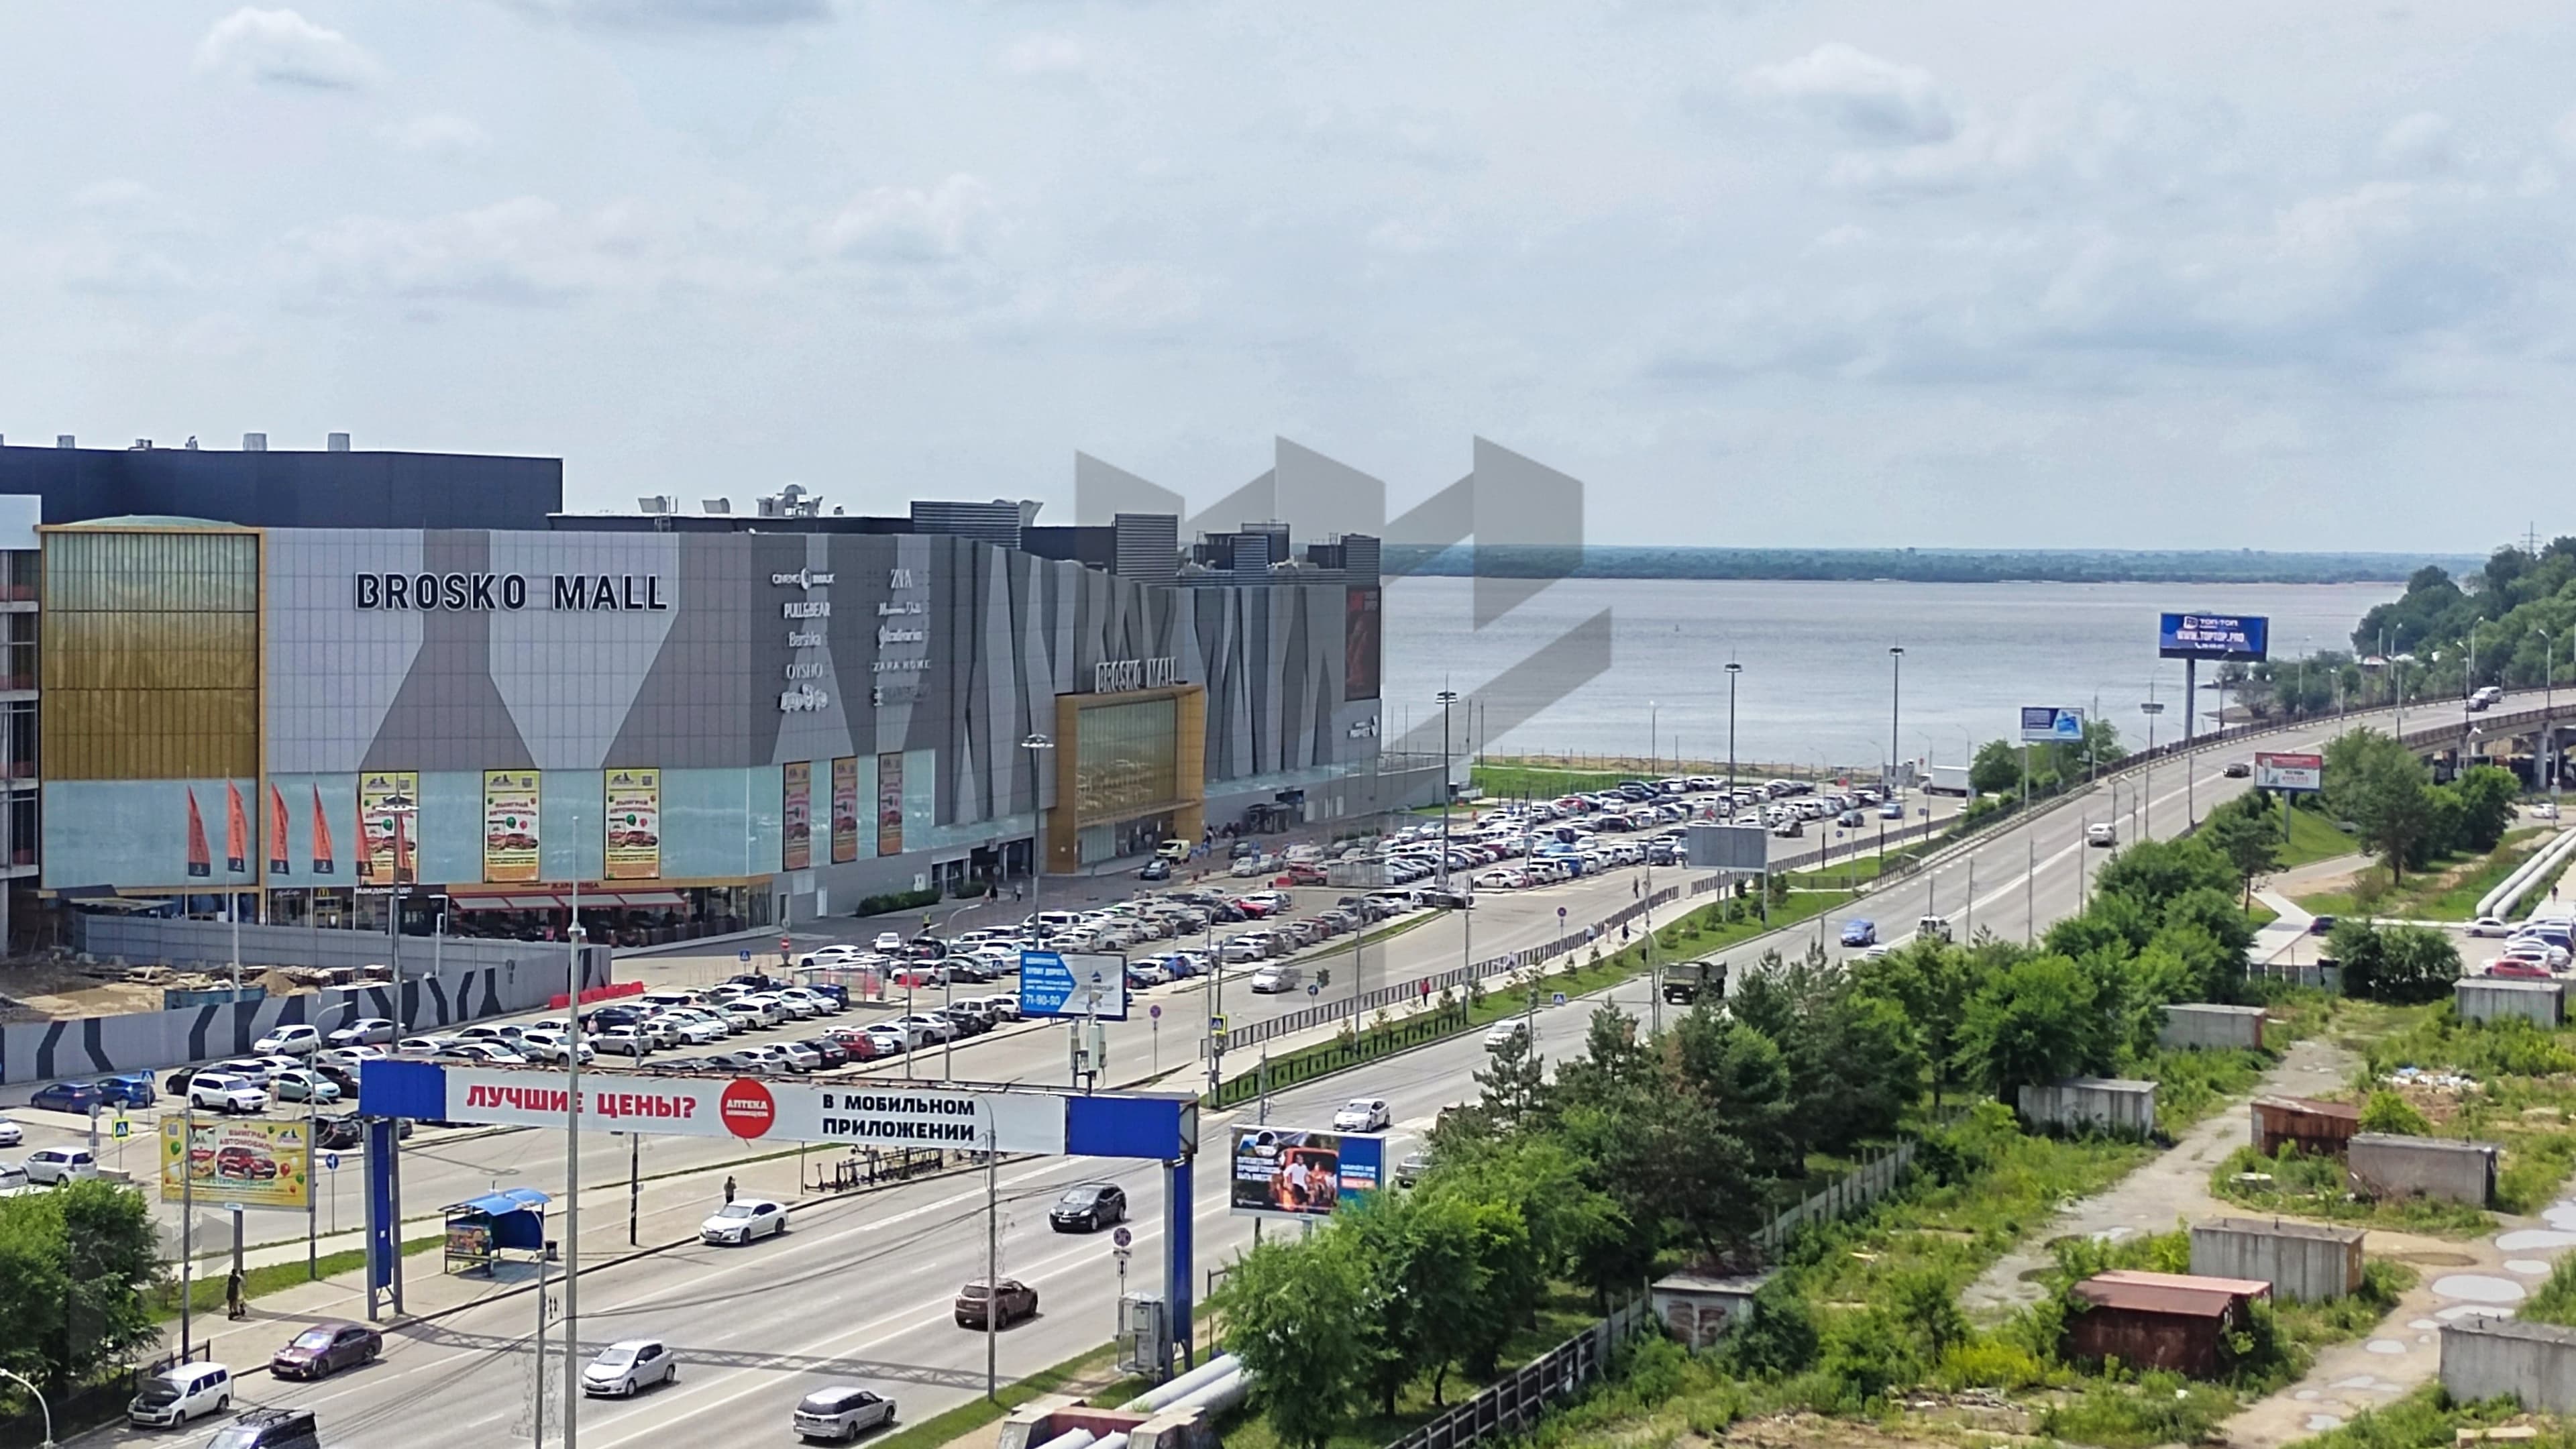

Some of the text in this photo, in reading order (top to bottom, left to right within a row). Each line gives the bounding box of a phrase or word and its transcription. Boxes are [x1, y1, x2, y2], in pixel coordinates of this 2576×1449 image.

[355, 572, 668, 611] BROSKO MALL
[786, 663, 824, 680] OYSHO
[1095, 657, 1176, 694] BROSKO MALL
[596, 1093, 696, 1119] ЦЕНЫ?
[726, 1098, 768, 1110] АПТЕКА
[823, 1093, 975, 1116] В МОБИЛЬНОМ
[228, 1129, 268, 1139] ВЫИГРАЙ
[823, 1118, 975, 1140] ПРИЛОЖЕНИИ
[219, 1138, 275, 1152] АВТОМОБИЛЬ
